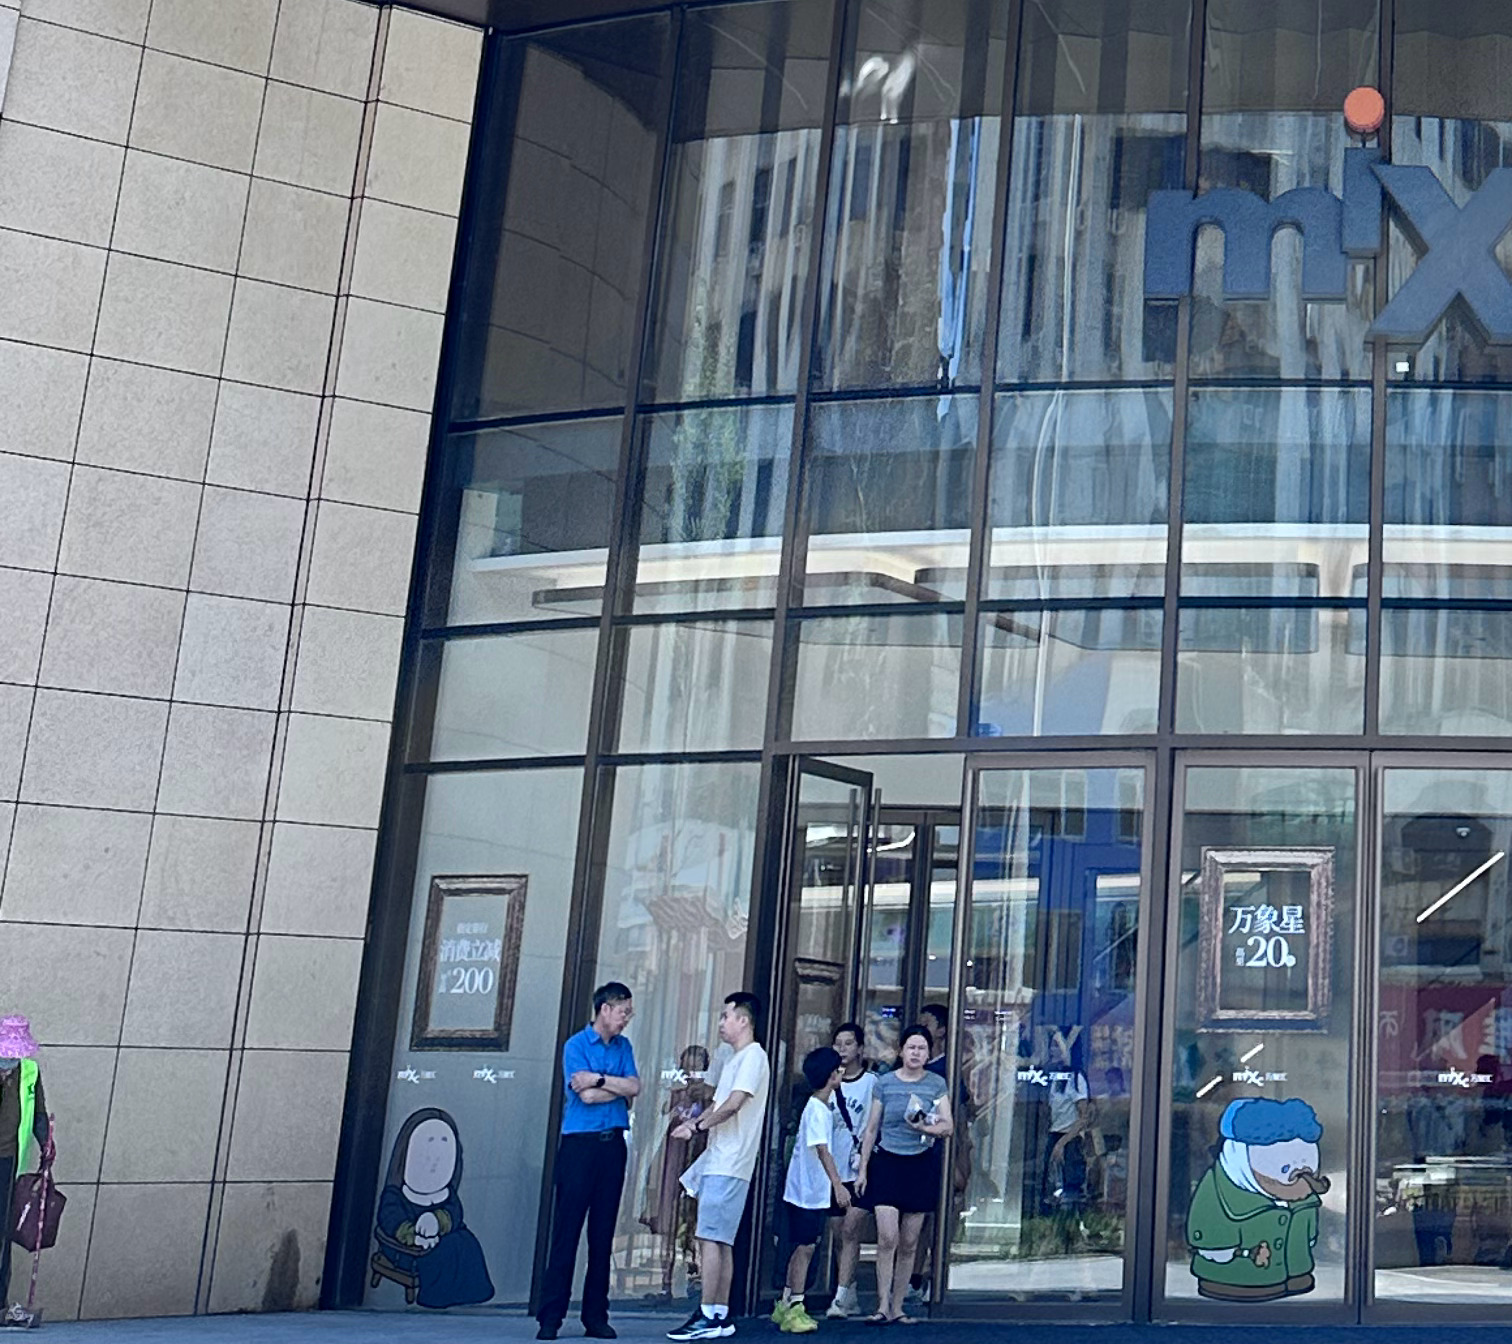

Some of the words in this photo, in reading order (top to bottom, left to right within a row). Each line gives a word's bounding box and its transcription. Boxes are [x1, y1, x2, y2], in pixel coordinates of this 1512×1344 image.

[1228, 904, 1306, 934] 万象星
[1245, 935, 1290, 968] 20
[450, 967, 494, 994] 200
